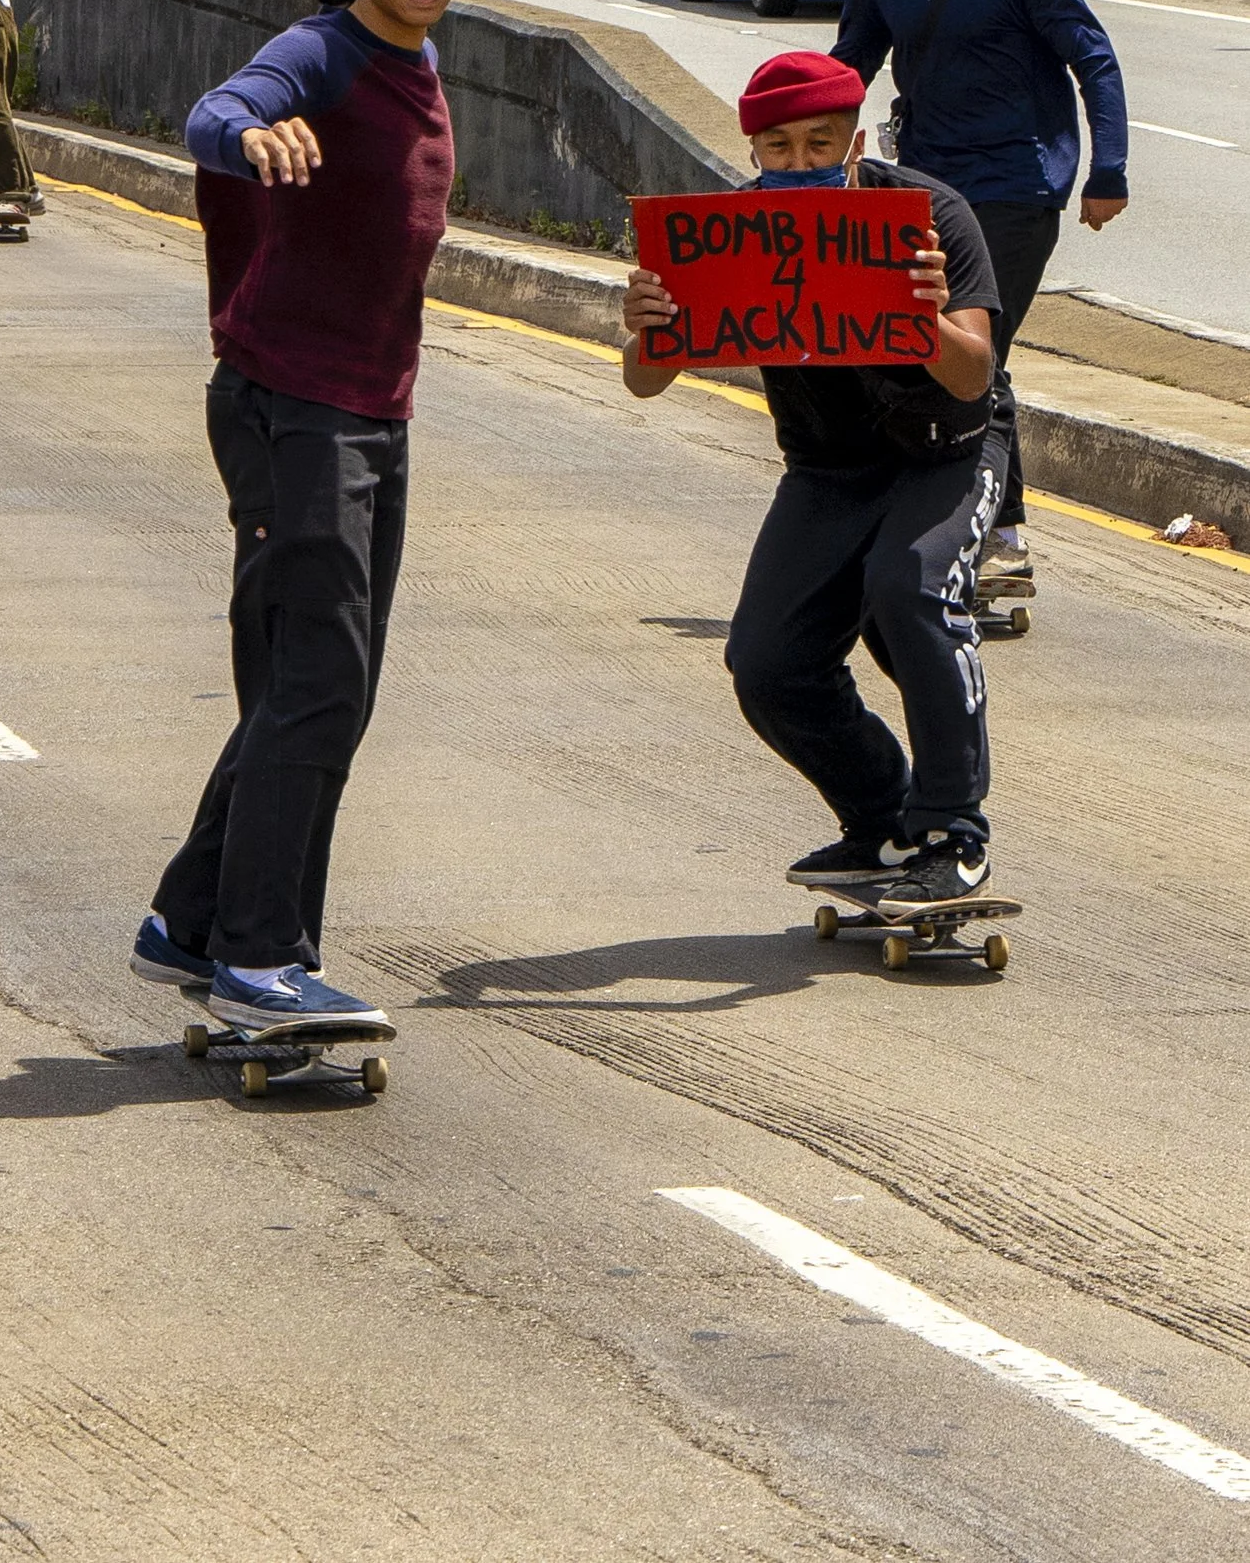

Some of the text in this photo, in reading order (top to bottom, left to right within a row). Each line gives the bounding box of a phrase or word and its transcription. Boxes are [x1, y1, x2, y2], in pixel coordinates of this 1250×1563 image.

[665, 209, 934, 271] BOMB HILLS
[771, 255, 806, 304] 4
[646, 299, 935, 360] BLACK LIVES
